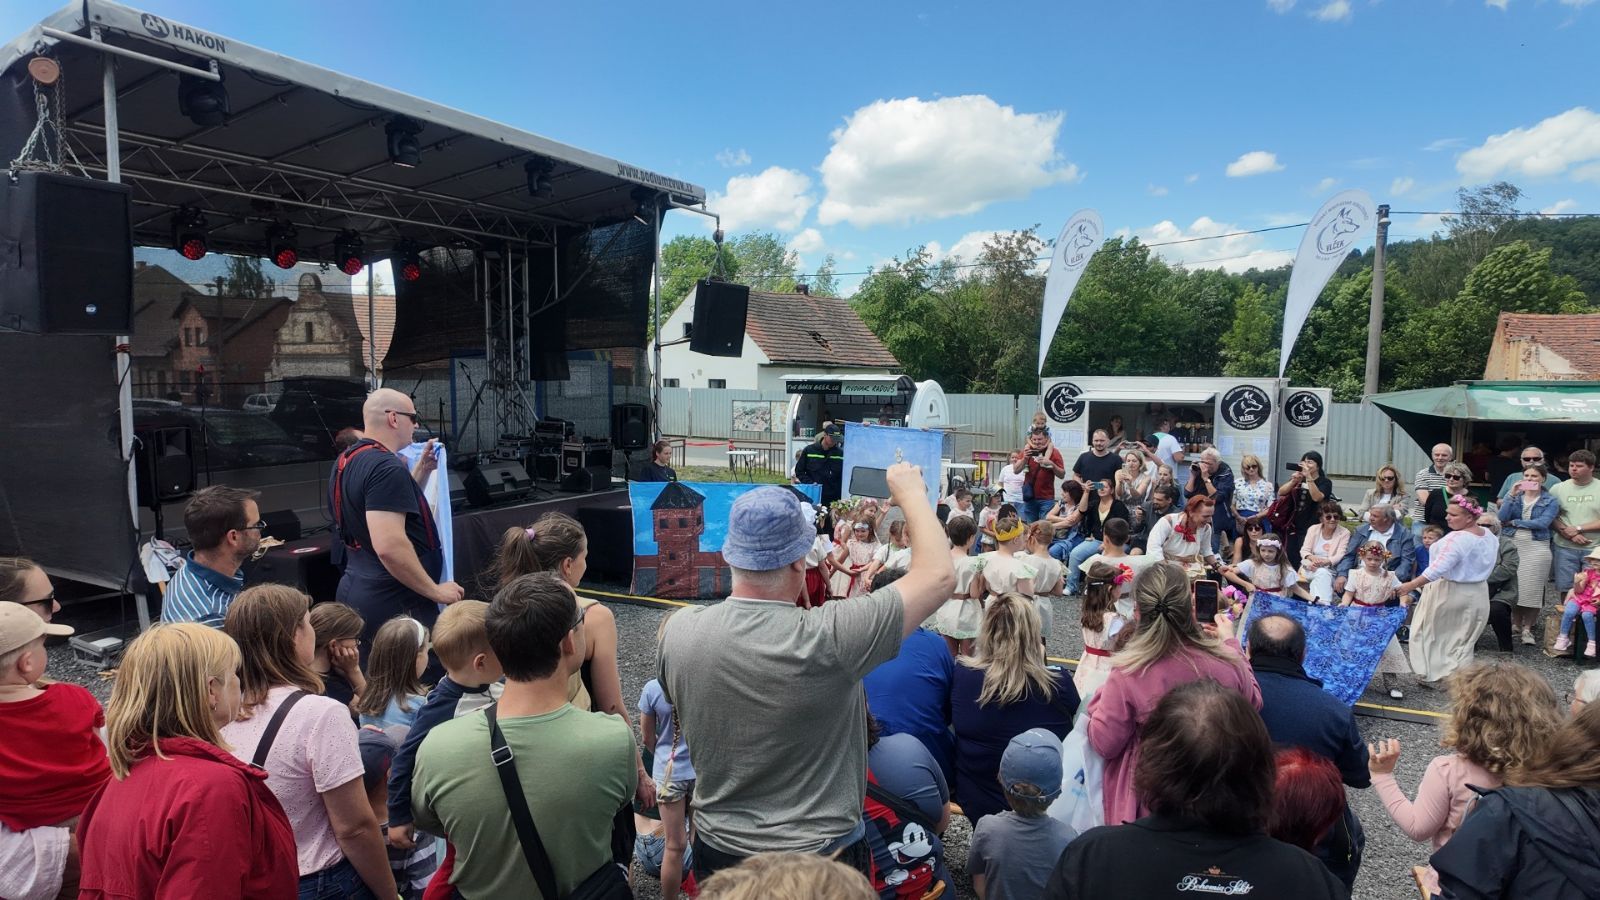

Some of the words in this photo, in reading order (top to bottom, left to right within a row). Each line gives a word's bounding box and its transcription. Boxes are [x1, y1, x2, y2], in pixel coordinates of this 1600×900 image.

[173, 25, 226, 53] HAKON
[1506, 397, 1544, 406] U
[1239, 413, 1255, 422] VLČEK
[1177, 875, 1225, 892] Bohemia
[1224, 879, 1254, 895] Sekt
